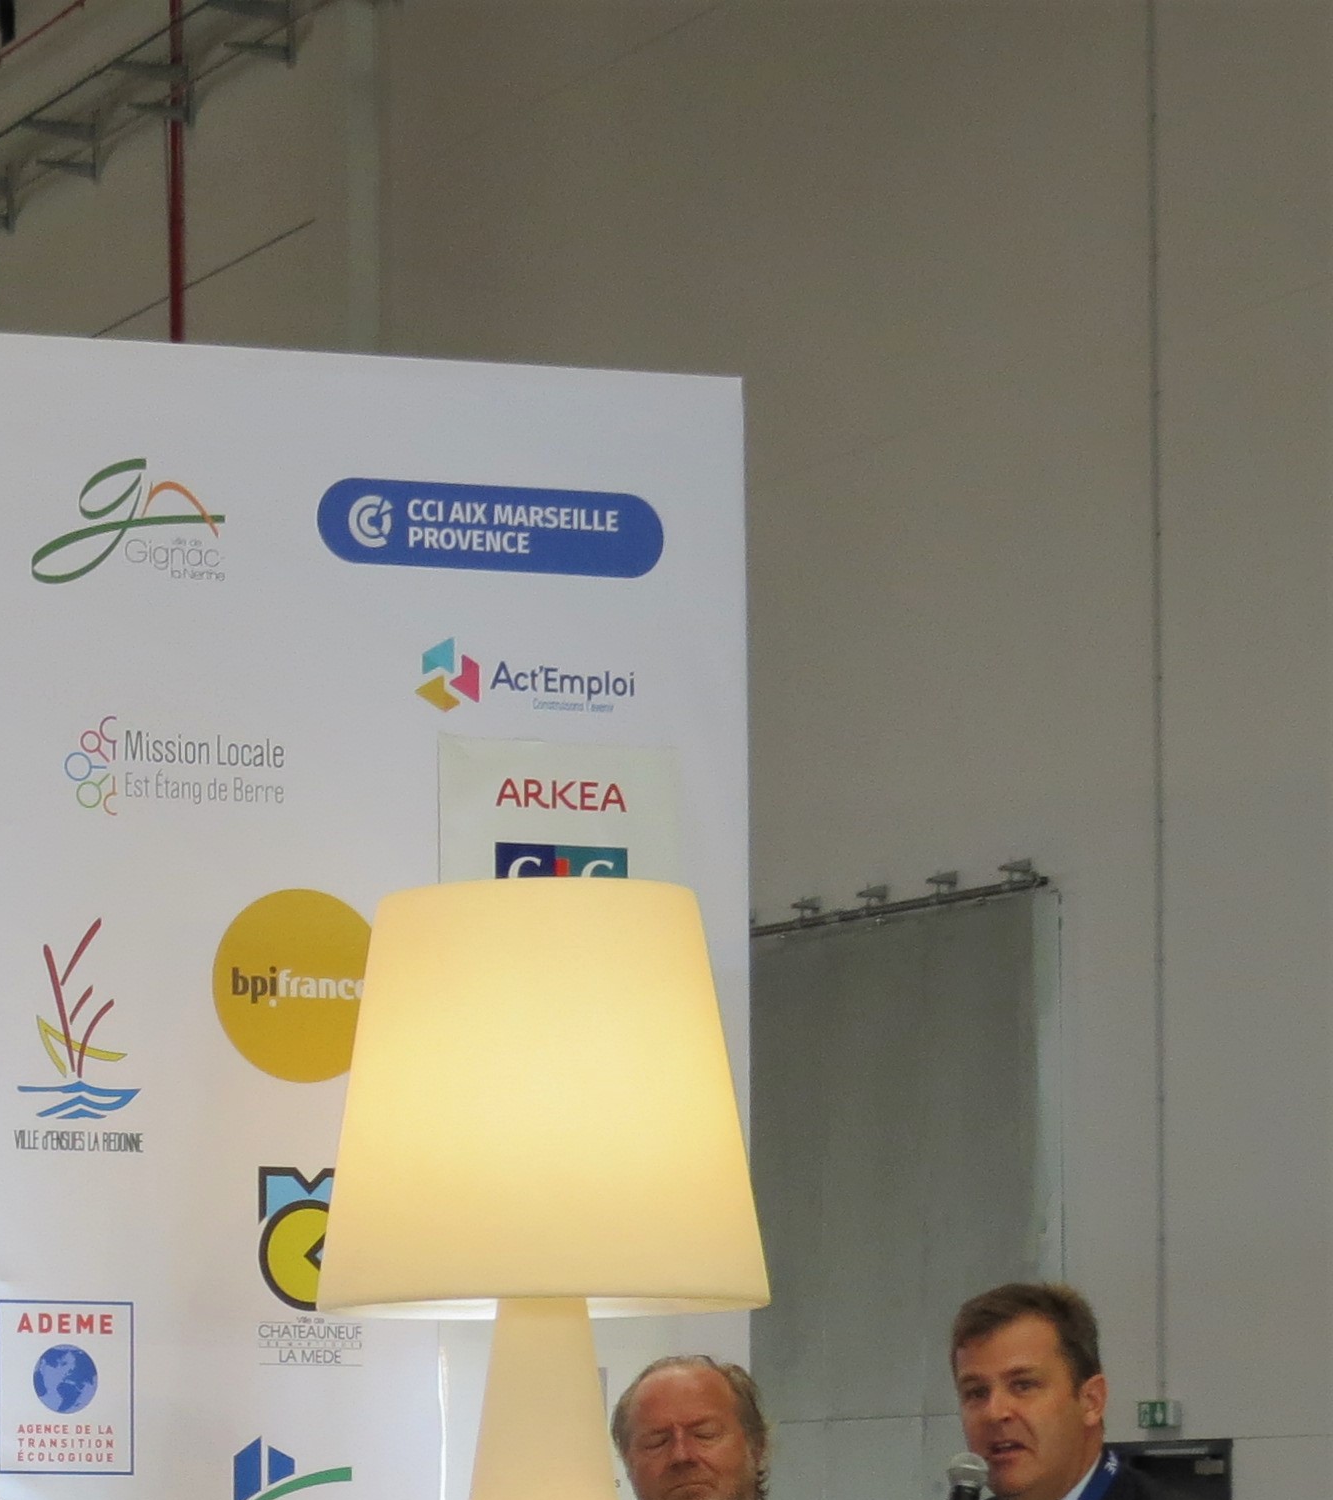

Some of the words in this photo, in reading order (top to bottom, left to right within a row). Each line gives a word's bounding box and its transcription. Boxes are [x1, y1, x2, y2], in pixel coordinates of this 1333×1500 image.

[407, 499, 444, 524] CCI
[449, 500, 485, 526] AIX
[492, 503, 619, 533] MARSEILLE
[408, 526, 530, 555] PROVENCE
[490, 661, 635, 700] Act'Emploi
[124, 730, 209, 765] Mission
[217, 734, 285, 769] Locale
[124, 774, 150, 799] Est
[154, 769, 201, 806] Étang
[207, 777, 228, 801] de
[233, 779, 284, 805] Berre
[496, 778, 627, 812] ARKEA
[14, 1129, 38, 1151] VILLE
[88, 1132, 100, 1152] LA
[102, 1131, 143, 1153] REDONNE
[17, 1313, 113, 1335] ADEME
[258, 1324, 362, 1340] CHATEAUNEUF
[279, 1350, 297, 1363] LA
[301, 1350, 341, 1364] MEDE
[17, 1424, 69, 1435] AGENCE
[74, 1425, 91, 1435] DE
[96, 1425, 114, 1435] LA
[17, 1439, 115, 1449] TRANSITION
[17, 1450, 115, 1463] ÉCOLOGIQUE
